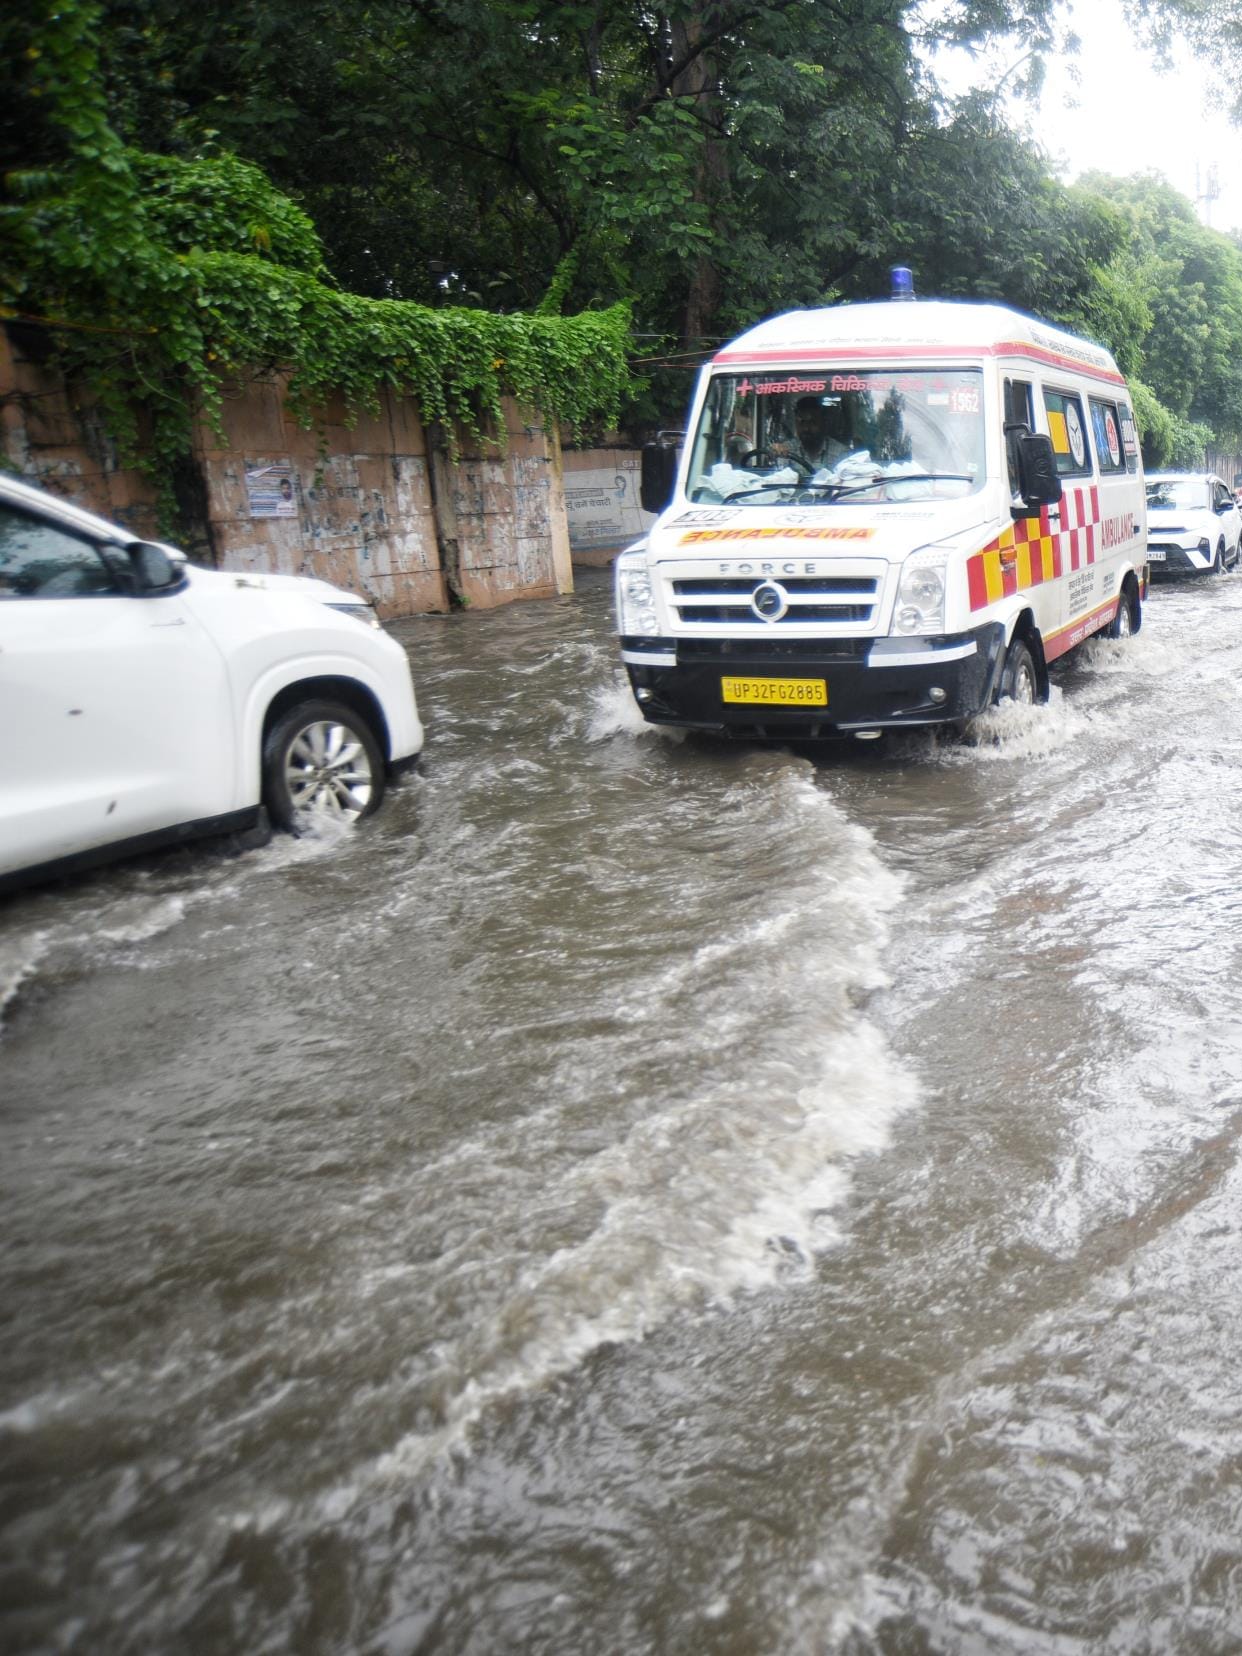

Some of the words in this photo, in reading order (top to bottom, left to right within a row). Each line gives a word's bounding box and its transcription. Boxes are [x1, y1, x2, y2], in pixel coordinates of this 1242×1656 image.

[755, 377, 827, 394] आकस्मिक
[1101, 513, 1135, 550] AMBULANCE
[719, 563, 817, 574] FORCE
[733, 683, 823, 700] UP32FG2885
